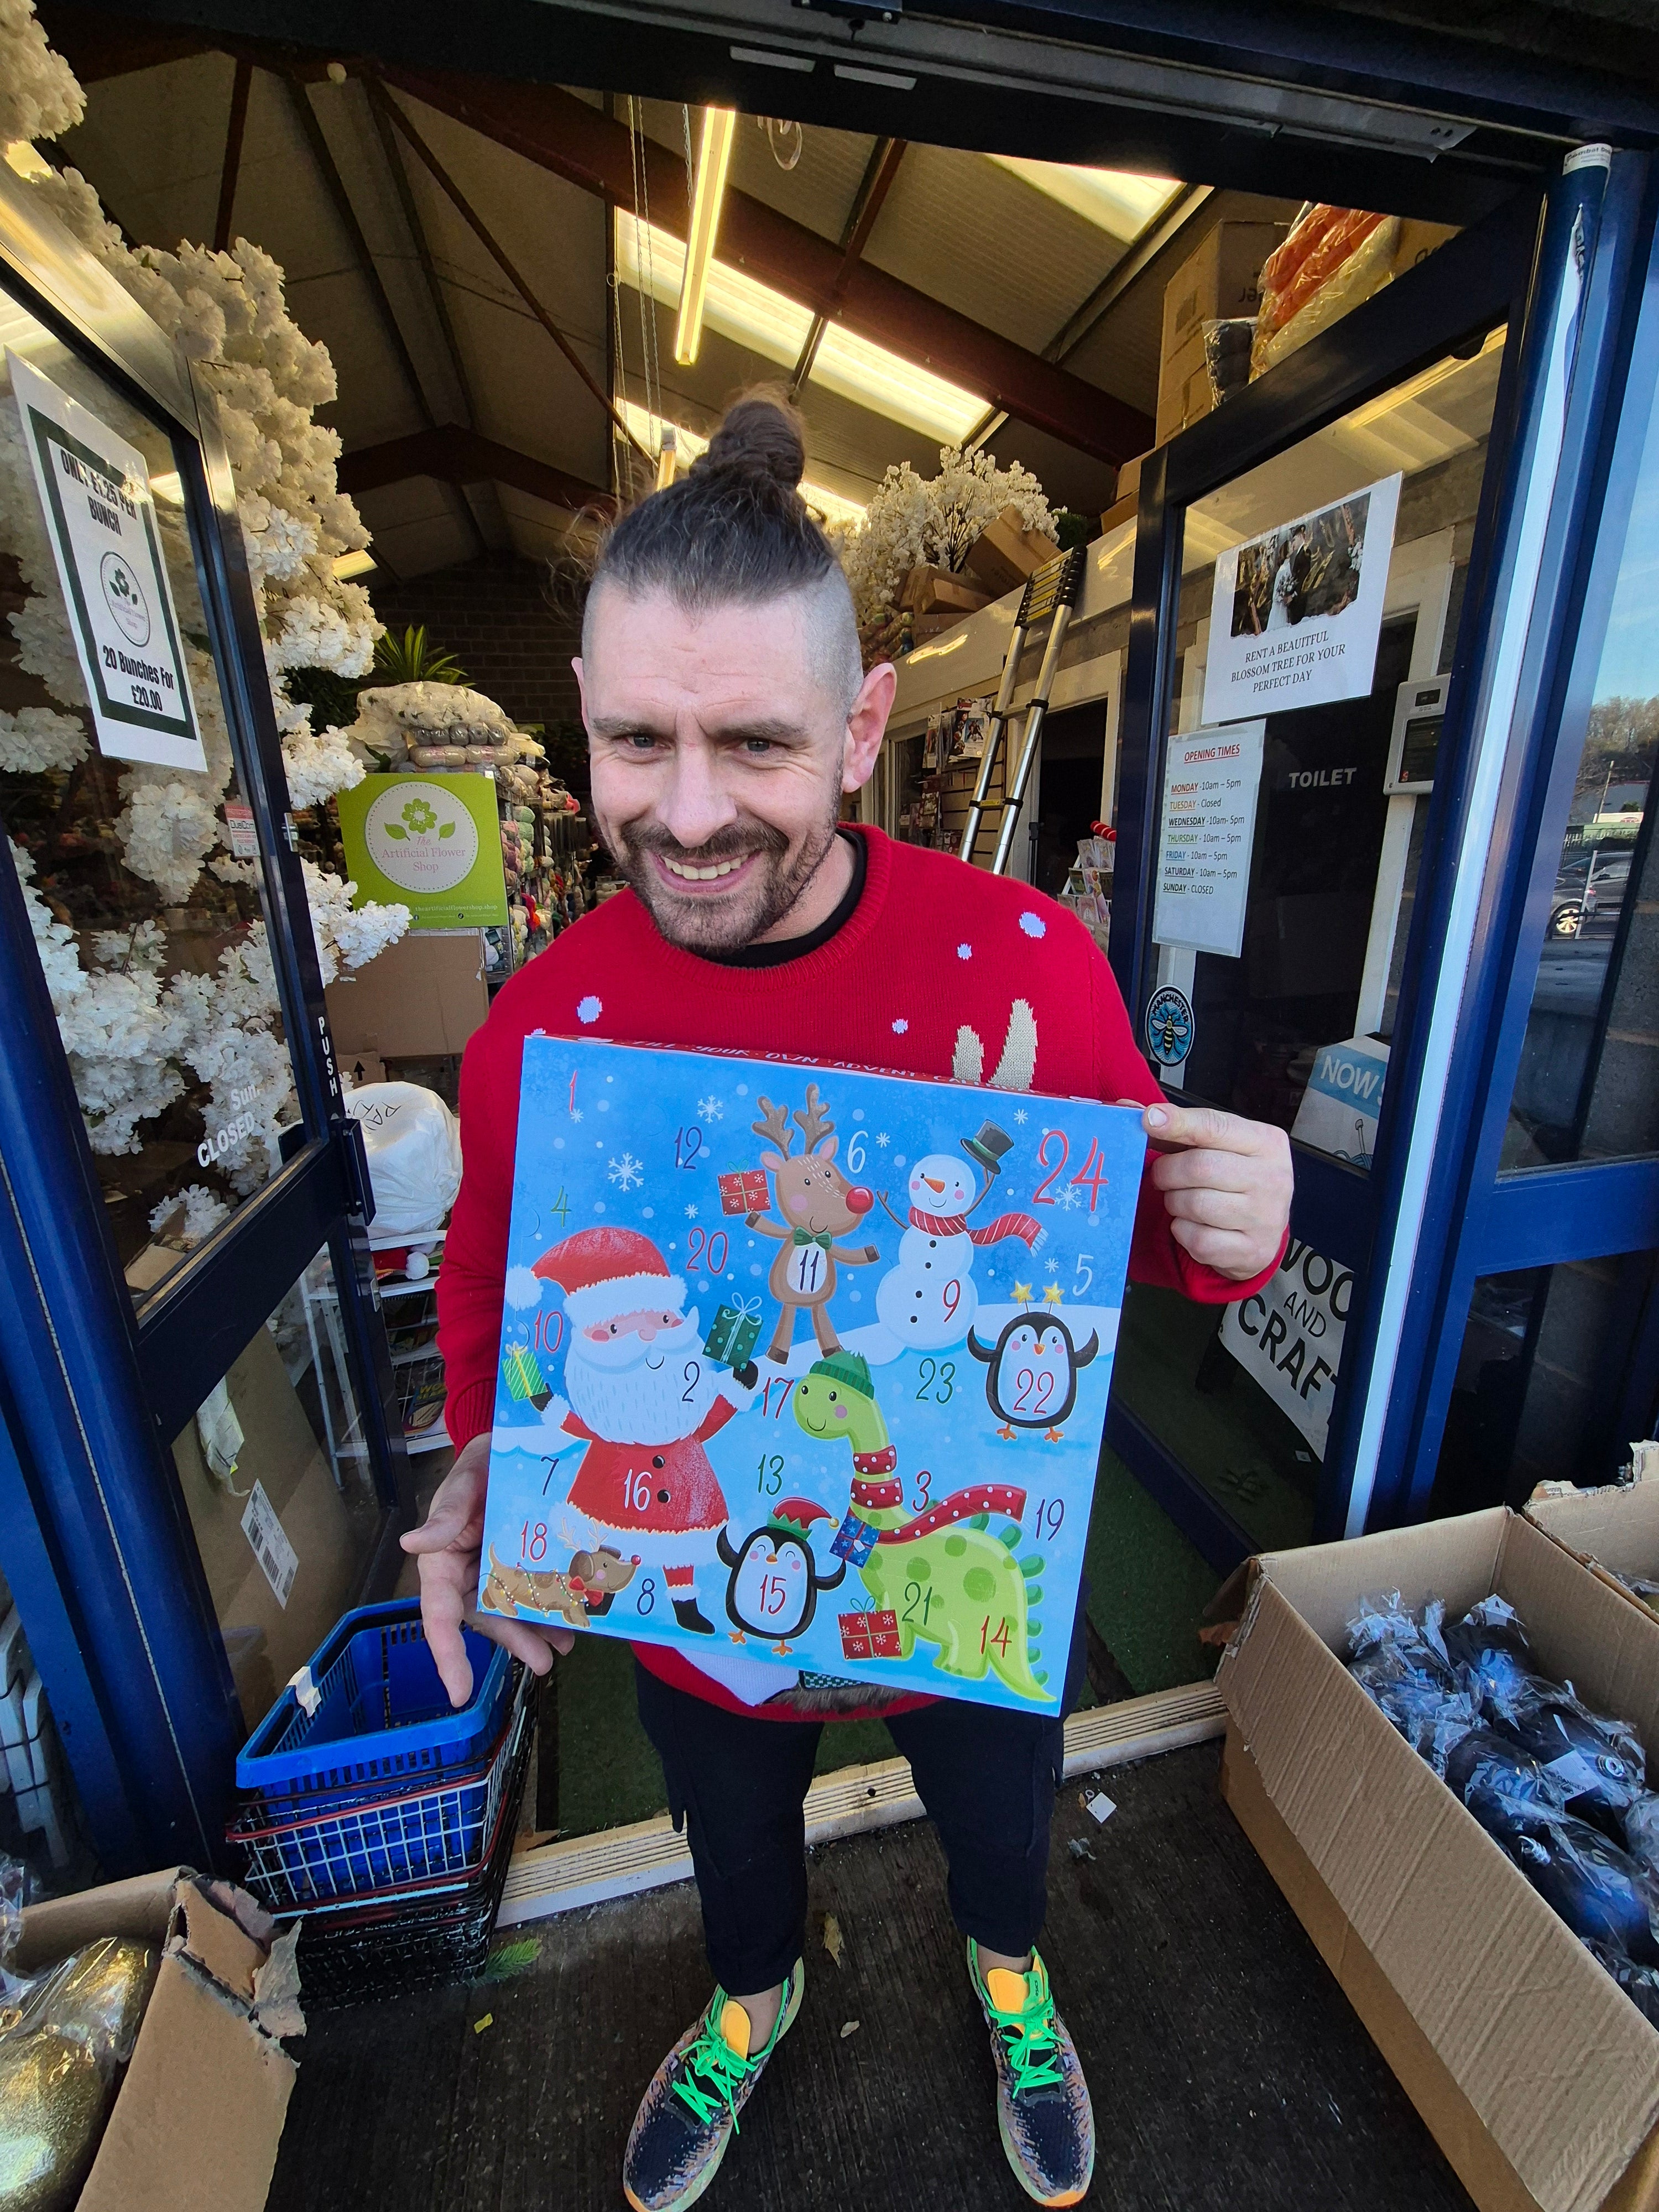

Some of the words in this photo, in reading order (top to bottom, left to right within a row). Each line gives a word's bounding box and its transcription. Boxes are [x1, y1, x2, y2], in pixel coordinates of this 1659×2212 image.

[87, 495, 122, 536] BUNCH
[1231, 664, 1270, 682] BLOSSOM
[1271, 657, 1295, 672] TREE
[1296, 652, 1314, 665] FOR
[1317, 644, 1345, 660] YOUR
[1245, 647, 1268, 662] RENT
[1269, 645, 1275, 656] A
[1277, 630, 1329, 654] BEAUITFUL
[103, 645, 117, 670] 20
[118, 650, 160, 685] Bunches
[160, 666, 174, 690] For
[1253, 675, 1291, 692] PERFECT
[1292, 669, 1313, 684] DAY
[131, 685, 163, 712] £20.00
[1184, 748, 1216, 763] OPENING
[1217, 744, 1240, 758] TIMES
[1171, 782, 1199, 795] MONDAY
[1226, 779, 1241, 790] 5pm
[1288, 767, 1357, 789] TOILET
[1168, 817, 1206, 828] WEDNESDAY
[1230, 815, 1245, 826] 5pm
[1170, 800, 1197, 811] TUESDAY
[1201, 797, 1222, 808] Closed
[382, 848, 429, 858] Artificial
[430, 848, 466, 857] Flower
[415, 836, 431, 846] The
[1166, 851, 1187, 860] FRIDAY
[1191, 851, 1207, 859] 10am
[1213, 851, 1228, 862] 5pm
[1167, 834, 1198, 844] THURSDAY
[1203, 833, 1220, 843] 10am
[1227, 833, 1241, 844] 5pm
[413, 861, 439, 873] Shop
[1165, 867, 1195, 878] SATURDAY
[1200, 868, 1216, 878] 10am
[1223, 869, 1238, 879] 5pm
[1163, 883, 1187, 894] SUNDAY
[1191, 885, 1214, 894] CLOSED
[1152, 994, 1189, 1023] MANCHESTER
[318, 1016, 338, 1097] PUSH
[765, 1052, 819, 1064] OWN
[1321, 1055, 1380, 1099] NOW
[570, 1070, 578, 1112] 1
[197, 1111, 254, 1167] CLOSED
[674, 1126, 703, 1170] 12
[847, 1130, 869, 1173] 6
[1032, 1129, 1109, 1212] 24
[551, 1186, 572, 1227] 4
[686, 1228, 728, 1274] 20
[799, 1249, 820, 1292] 11
[1072, 1253, 1094, 1296] 5
[943, 1279, 961, 1323] 9
[1284, 1291, 1327, 1337] AND
[534, 1310, 564, 1353] 10
[1238, 1293, 1337, 1400] CRAF
[681, 1361, 700, 1403] 2
[762, 1376, 795, 1420] 17
[915, 1357, 957, 1404] 23
[1013, 1368, 1055, 1415] 22
[540, 1456, 560, 1496] 7
[624, 1469, 653, 1511] 16
[757, 1453, 785, 1496] 13
[912, 1470, 932, 1512] 3
[521, 1520, 547, 1561] 18
[1035, 1498, 1065, 1542] 19
[637, 1578, 656, 1616] 8
[759, 1574, 786, 1615] 15
[901, 1582, 932, 1626] 21
[979, 1615, 1012, 1658] 14
